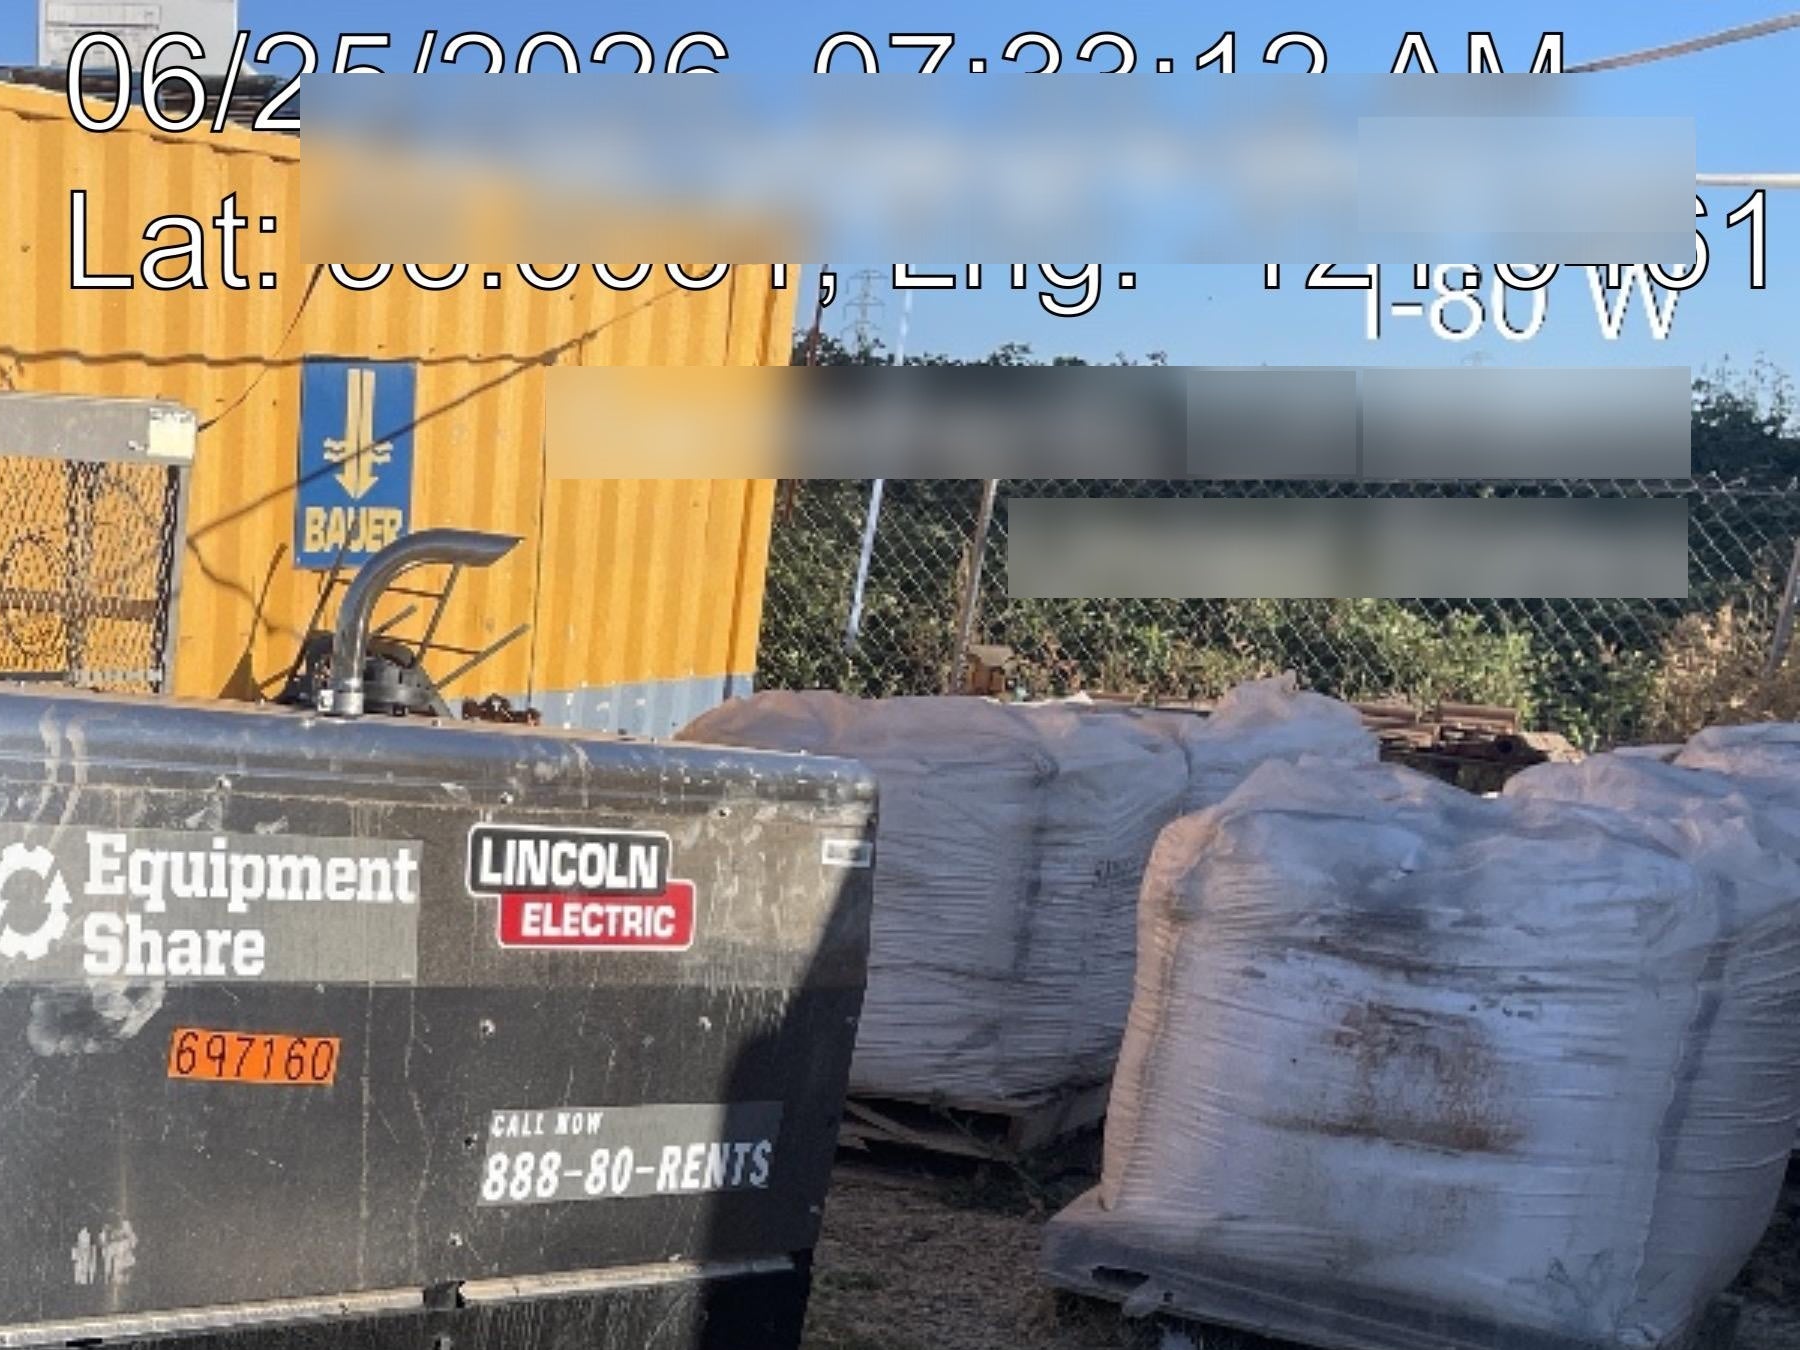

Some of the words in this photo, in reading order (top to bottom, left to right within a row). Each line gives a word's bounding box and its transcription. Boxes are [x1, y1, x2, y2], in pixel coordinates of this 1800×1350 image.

[83, 832, 418, 914] Equipment
[479, 837, 660, 889] LINCOLN
[83, 910, 266, 977] Share
[520, 902, 677, 938] ELECTRIC
[176, 1031, 335, 1081] 697160
[491, 1112, 545, 1138] CALL
[554, 1111, 604, 1135] NOW
[481, 1138, 773, 1201] 888-80-RENTS
